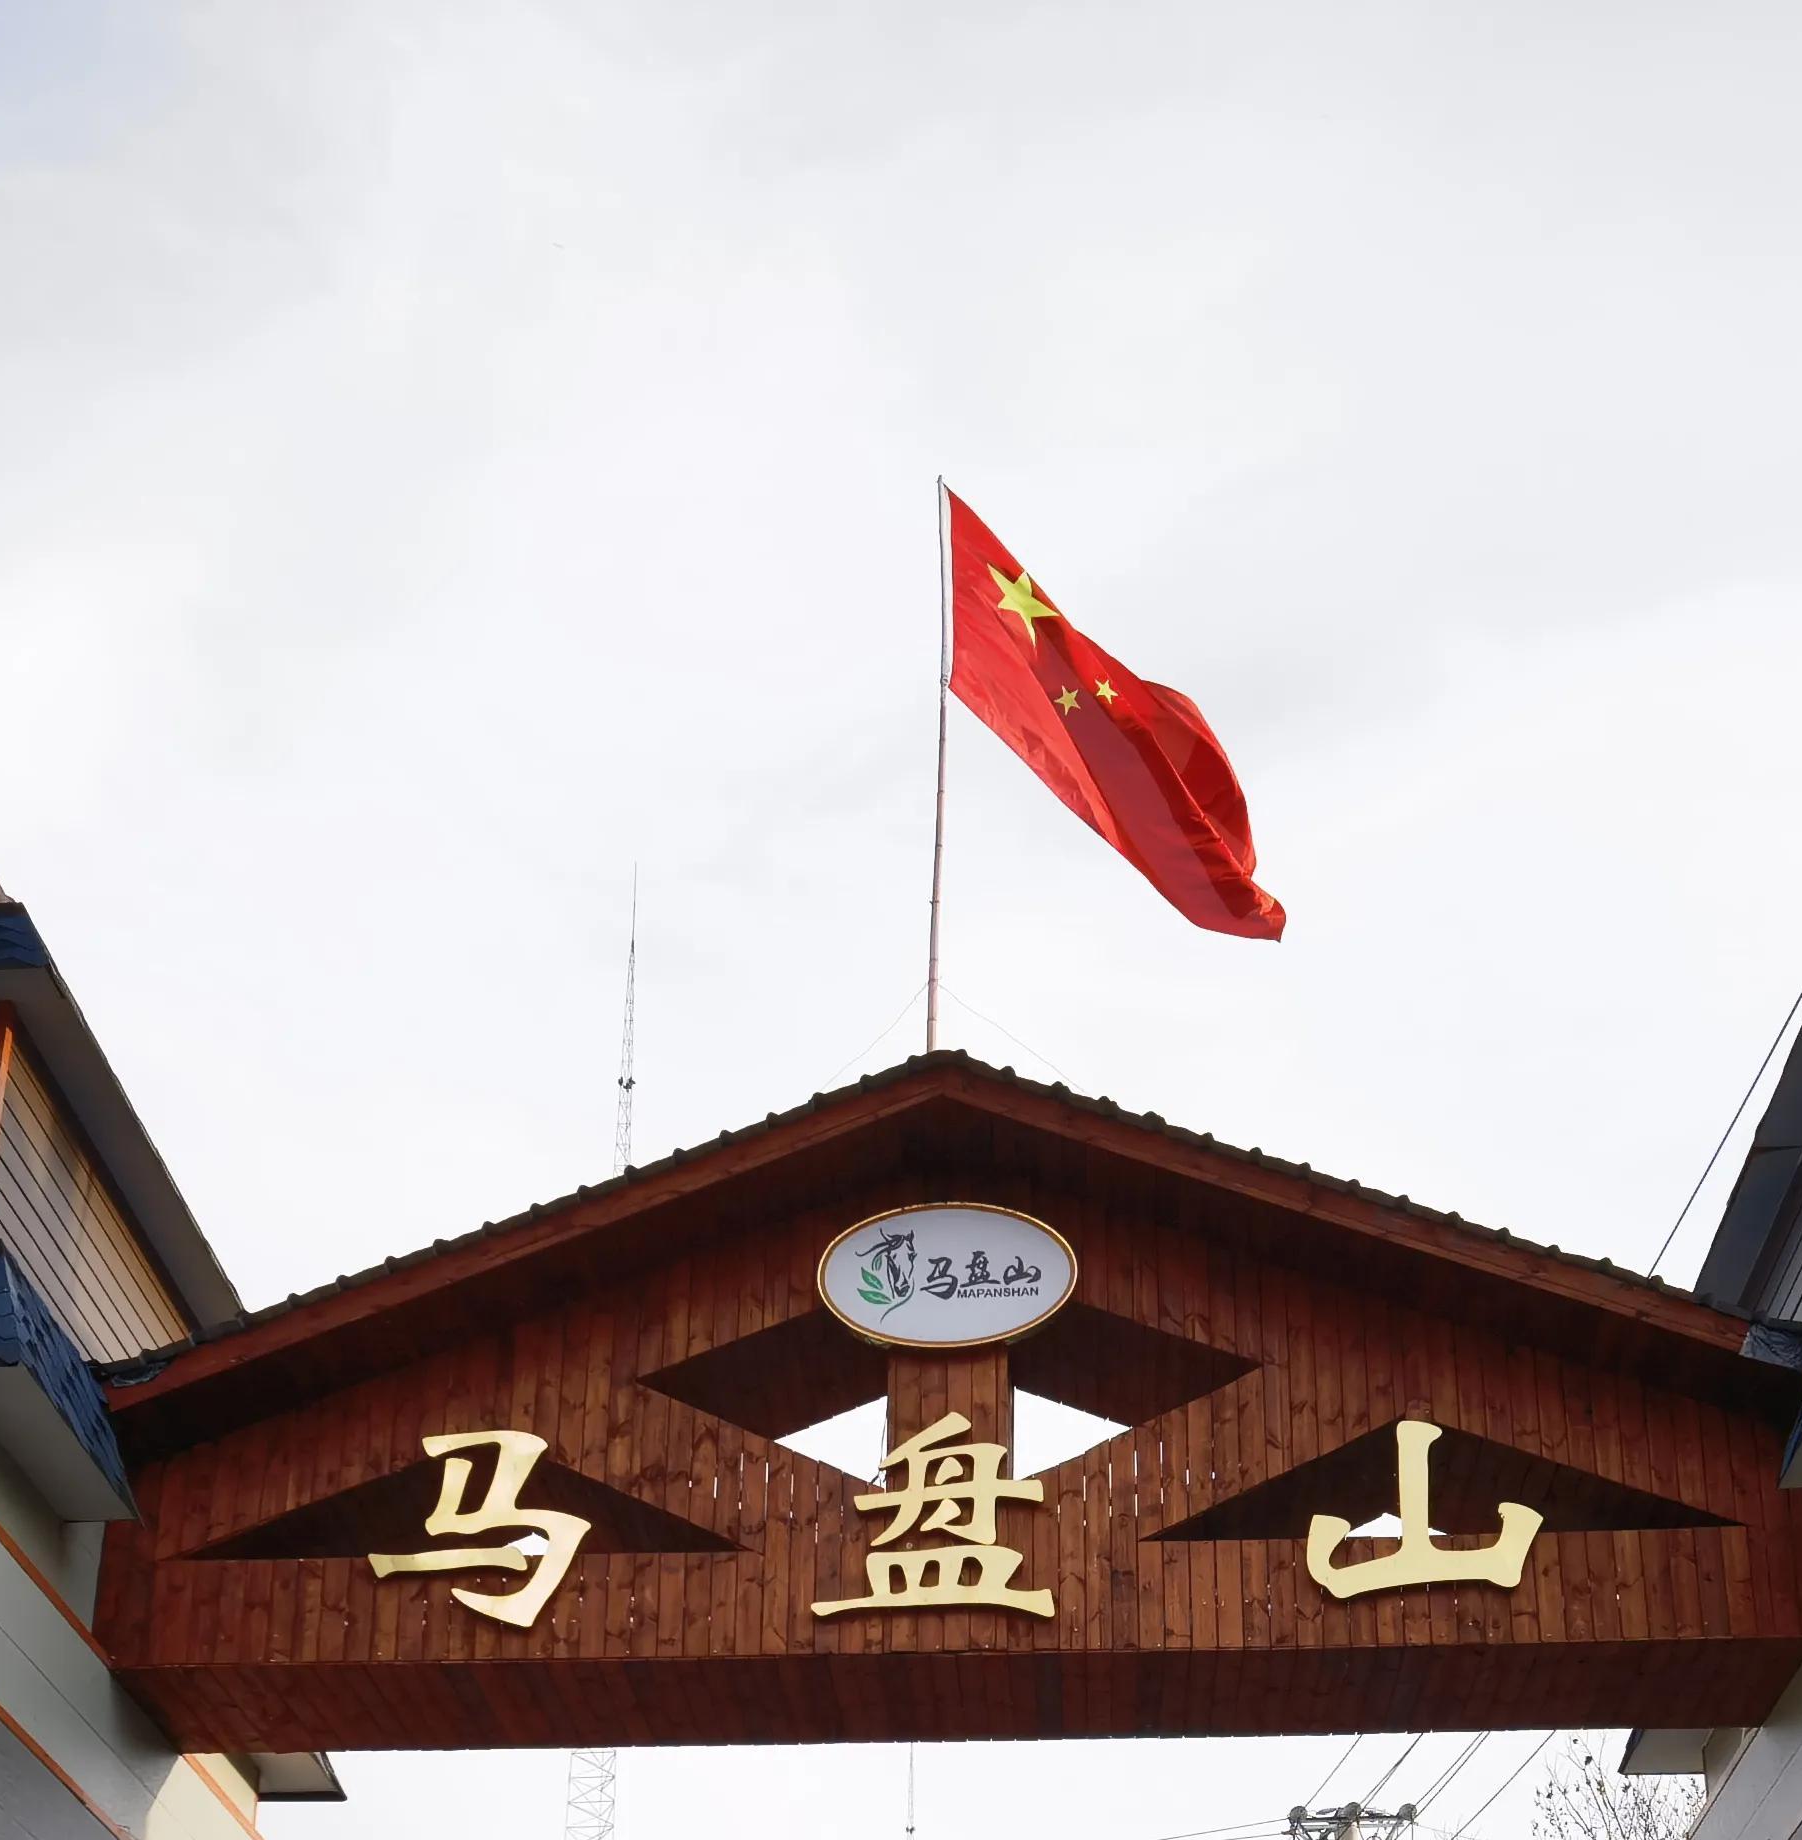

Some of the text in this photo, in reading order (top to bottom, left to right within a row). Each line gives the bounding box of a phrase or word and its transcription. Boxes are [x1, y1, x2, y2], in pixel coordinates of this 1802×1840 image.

[920, 1251, 1042, 1300] 马盘山
[957, 1286, 1039, 1299] MAPANSHAN
[368, 1411, 1544, 1627] 马盘山
